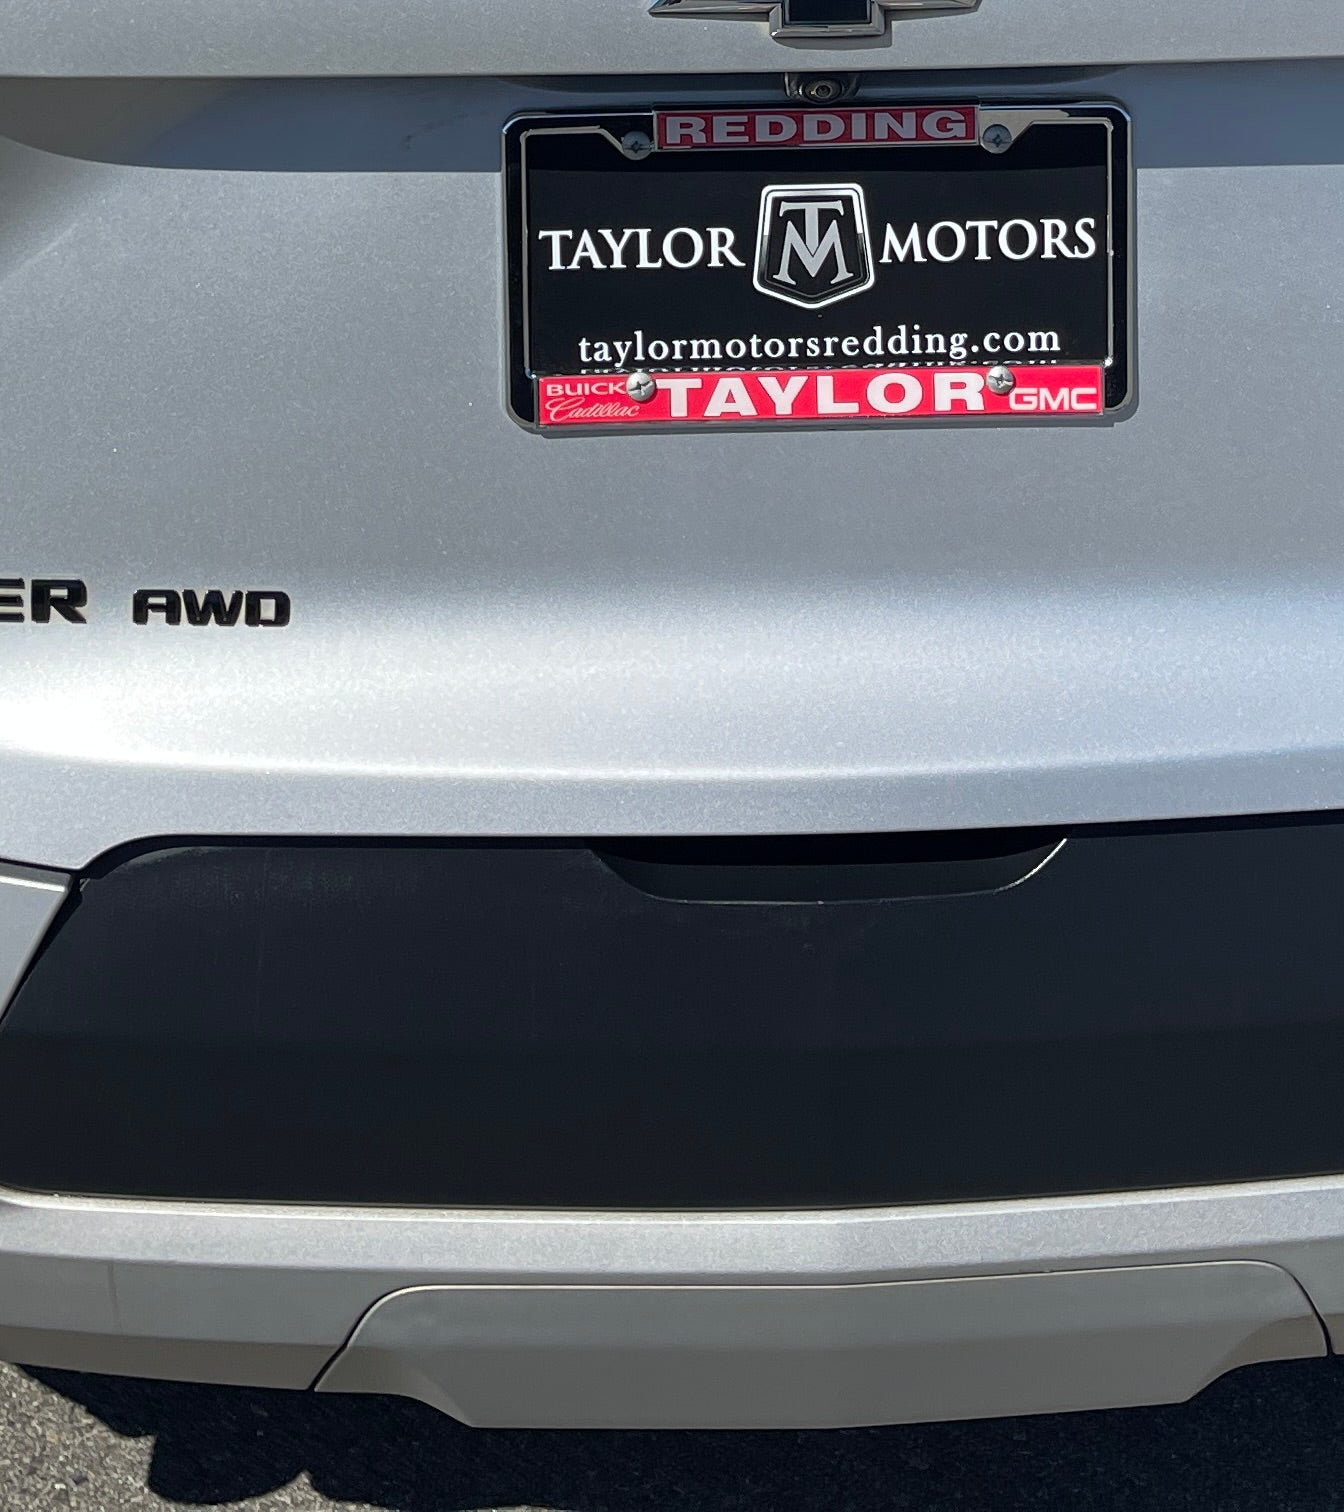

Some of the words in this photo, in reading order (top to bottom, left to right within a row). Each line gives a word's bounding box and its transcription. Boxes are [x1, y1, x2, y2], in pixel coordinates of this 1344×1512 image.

[664, 109, 967, 146] REDDING
[538, 226, 746, 272] TAYLOR
[878, 217, 1097, 265] MOTORS
[578, 324, 1061, 366] taylormotorsredding.com
[546, 381, 627, 397] BUICK
[655, 372, 985, 417] TAYLOR
[1009, 386, 1098, 412] GMC
[545, 396, 640, 422] Cadillac
[132, 589, 292, 627] AWD
